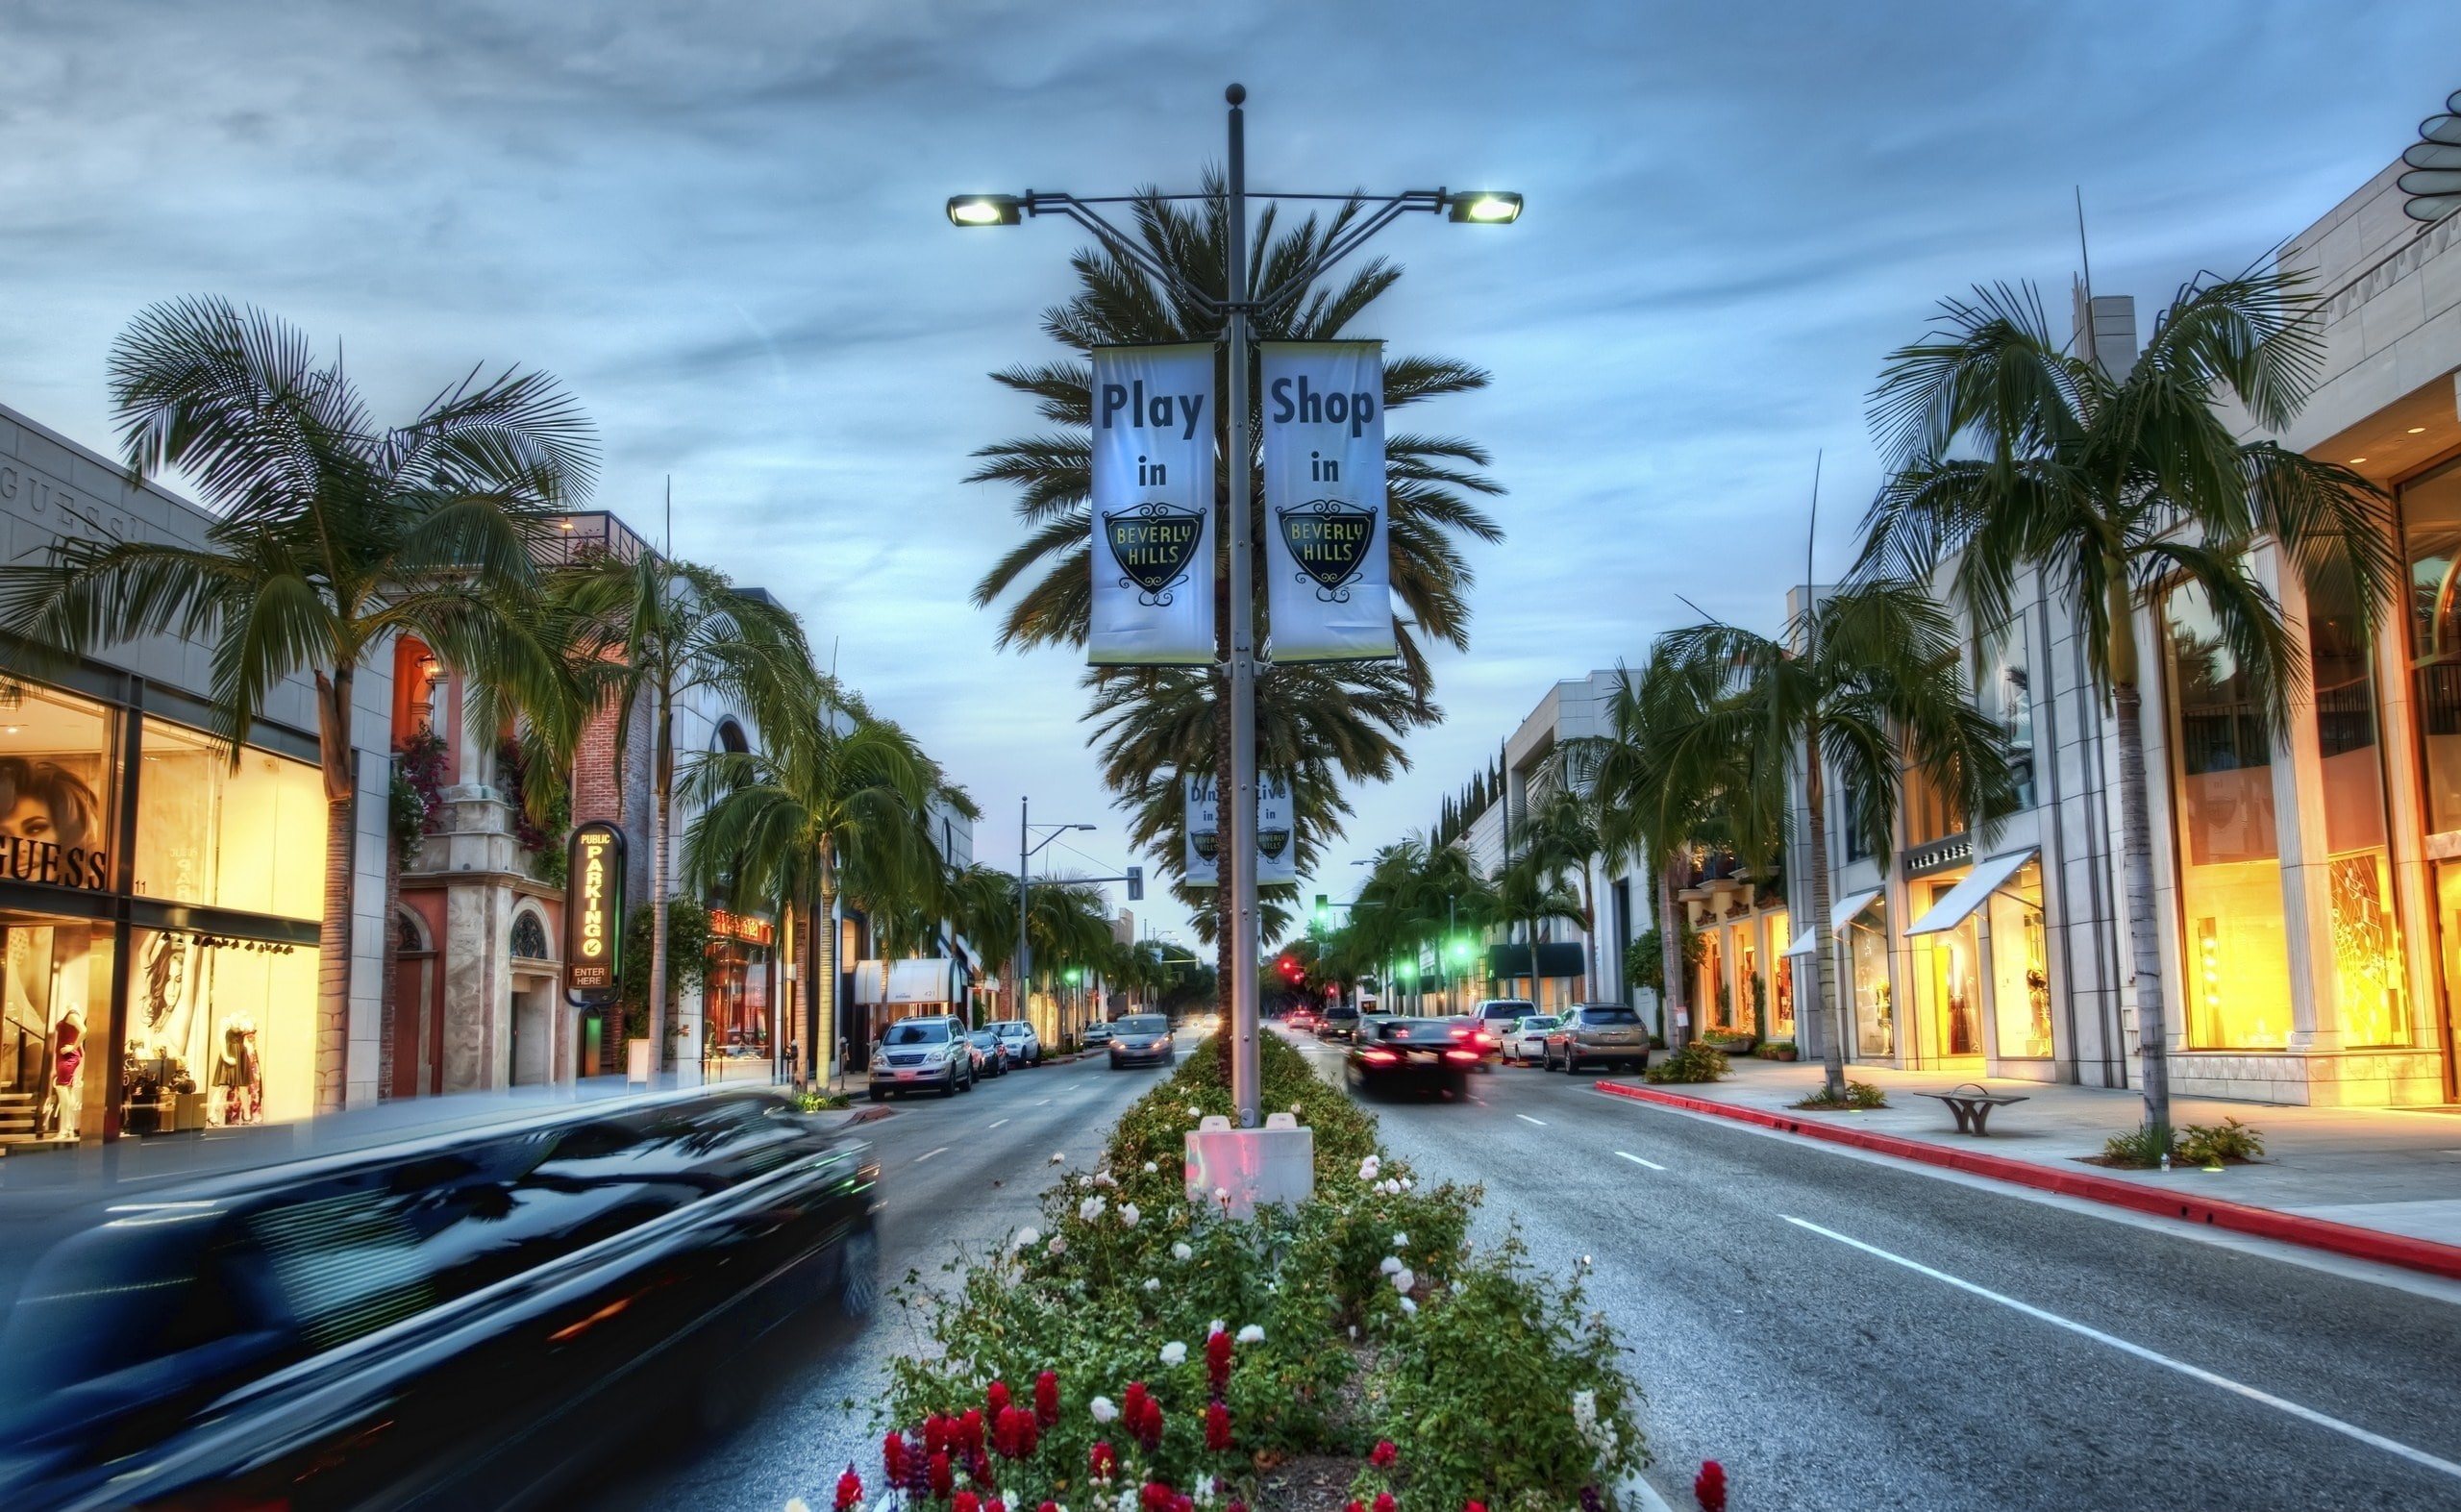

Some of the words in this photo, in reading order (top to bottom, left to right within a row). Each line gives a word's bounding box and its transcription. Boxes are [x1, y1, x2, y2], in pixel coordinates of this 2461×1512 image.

[1102, 380, 1205, 440] Play
[1271, 375, 1375, 438] Shop
[1138, 456, 1167, 486] in
[1311, 452, 1339, 482] in
[1117, 525, 1192, 545] BEVERLY
[1291, 522, 1363, 542] BEVERLY
[1129, 545, 1179, 565] HILLS
[1304, 543, 1353, 562] HILLS
[1191, 785, 1218, 803] Din
[1257, 784, 1286, 801] ive
[1204, 810, 1213, 822] in
[1266, 808, 1276, 820] in
[581, 834, 610, 845] PUBLIC
[0, 834, 106, 893] UESS
[584, 846, 604, 937] PARKING
[575, 967, 605, 977] ENTER
[577, 977, 602, 985] HERE
